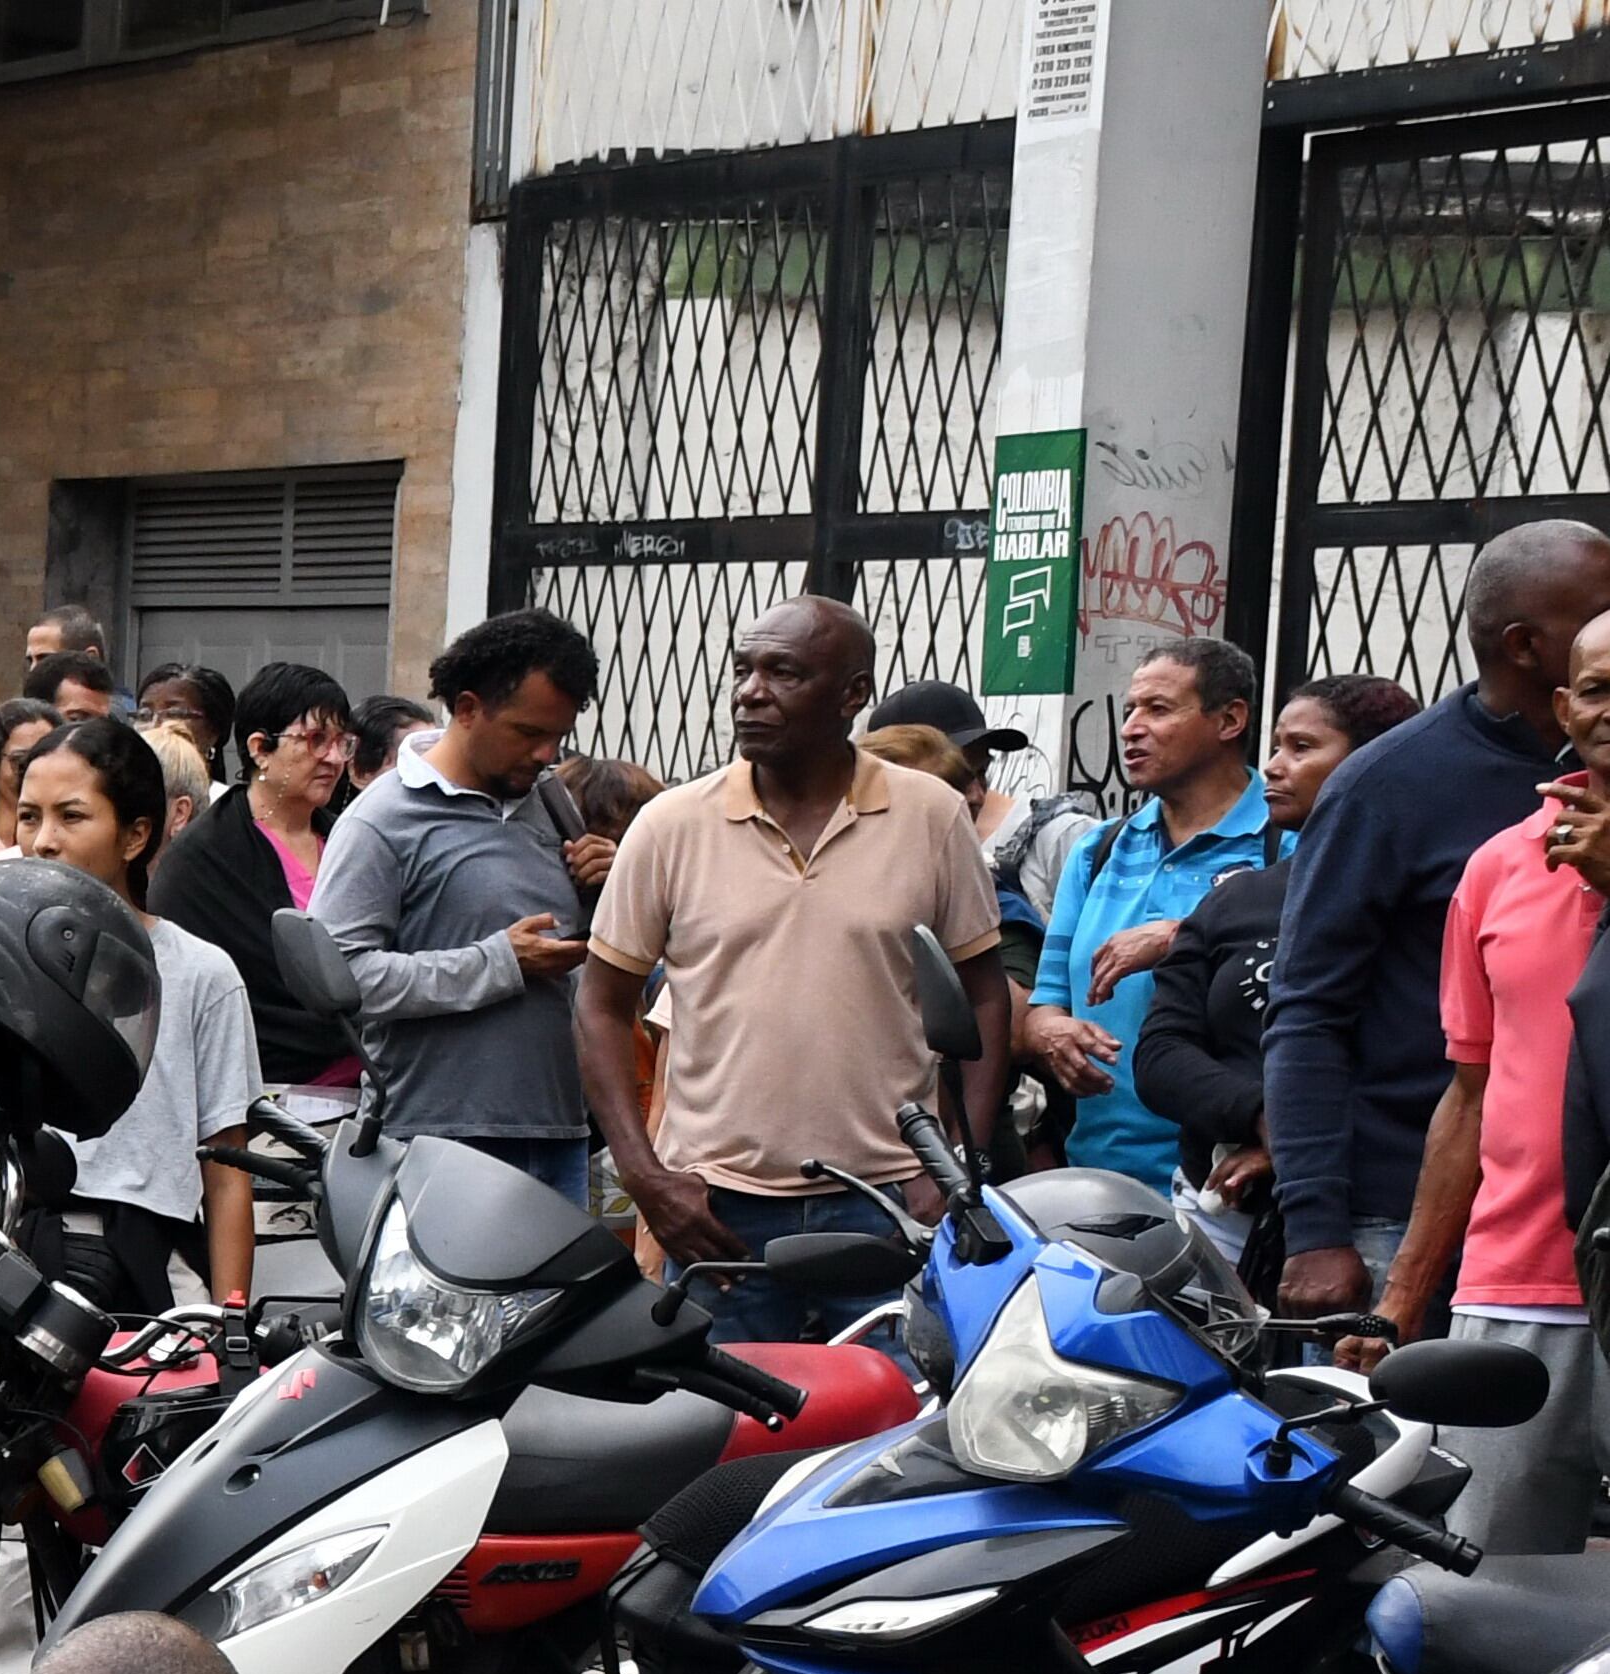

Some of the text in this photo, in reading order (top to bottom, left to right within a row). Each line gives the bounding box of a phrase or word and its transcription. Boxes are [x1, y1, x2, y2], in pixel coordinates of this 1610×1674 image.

[995, 469, 1071, 532] COLOMBIA
[994, 531, 1070, 562] HABLAR
[1073, 1616, 1129, 1644] ZUKI
